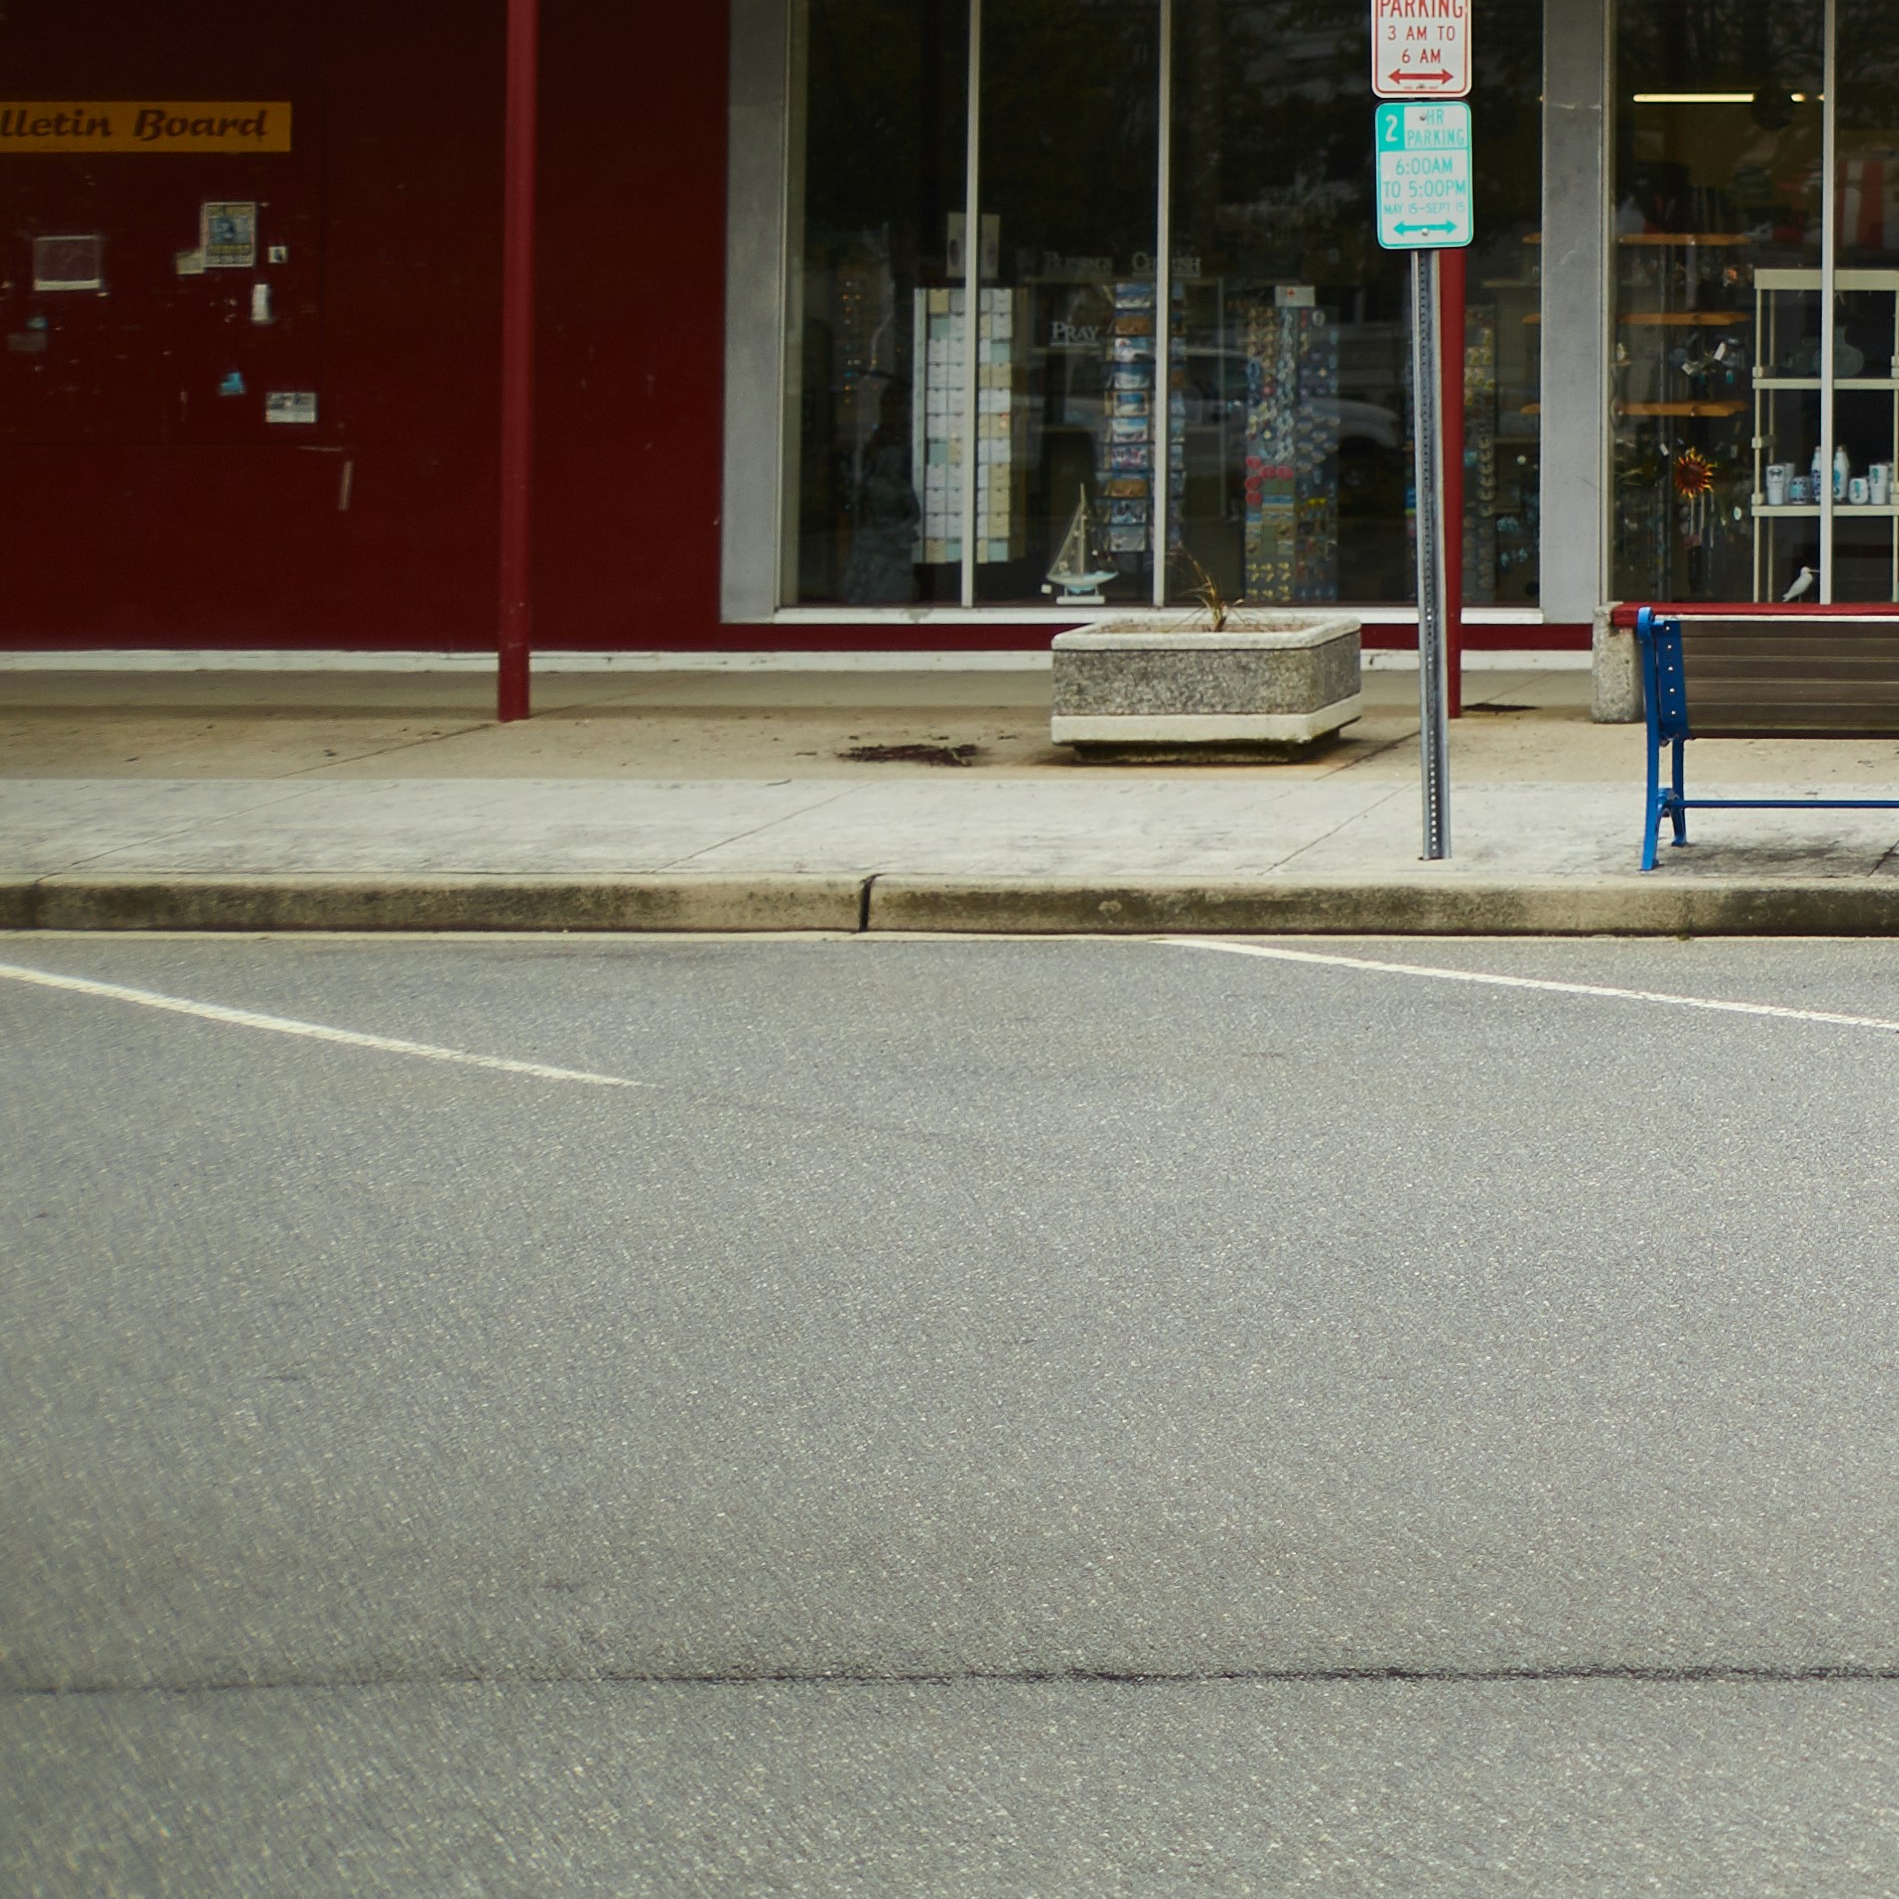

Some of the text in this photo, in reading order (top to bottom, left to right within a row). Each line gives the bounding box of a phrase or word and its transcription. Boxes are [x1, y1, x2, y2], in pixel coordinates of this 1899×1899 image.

[1387, 25, 1456, 41] 3 AM TO
[1402, 48, 1441, 64] 6 AM
[132, 108, 268, 142] Board
[1426, 109, 1444, 126] HR
[1385, 114, 1398, 143] 2
[1407, 128, 1465, 147] PARKING
[1396, 157, 1453, 175] 6:00AM
[1383, 178, 1466, 198] TO 5:00PM
[1383, 203, 1403, 215] MAY
